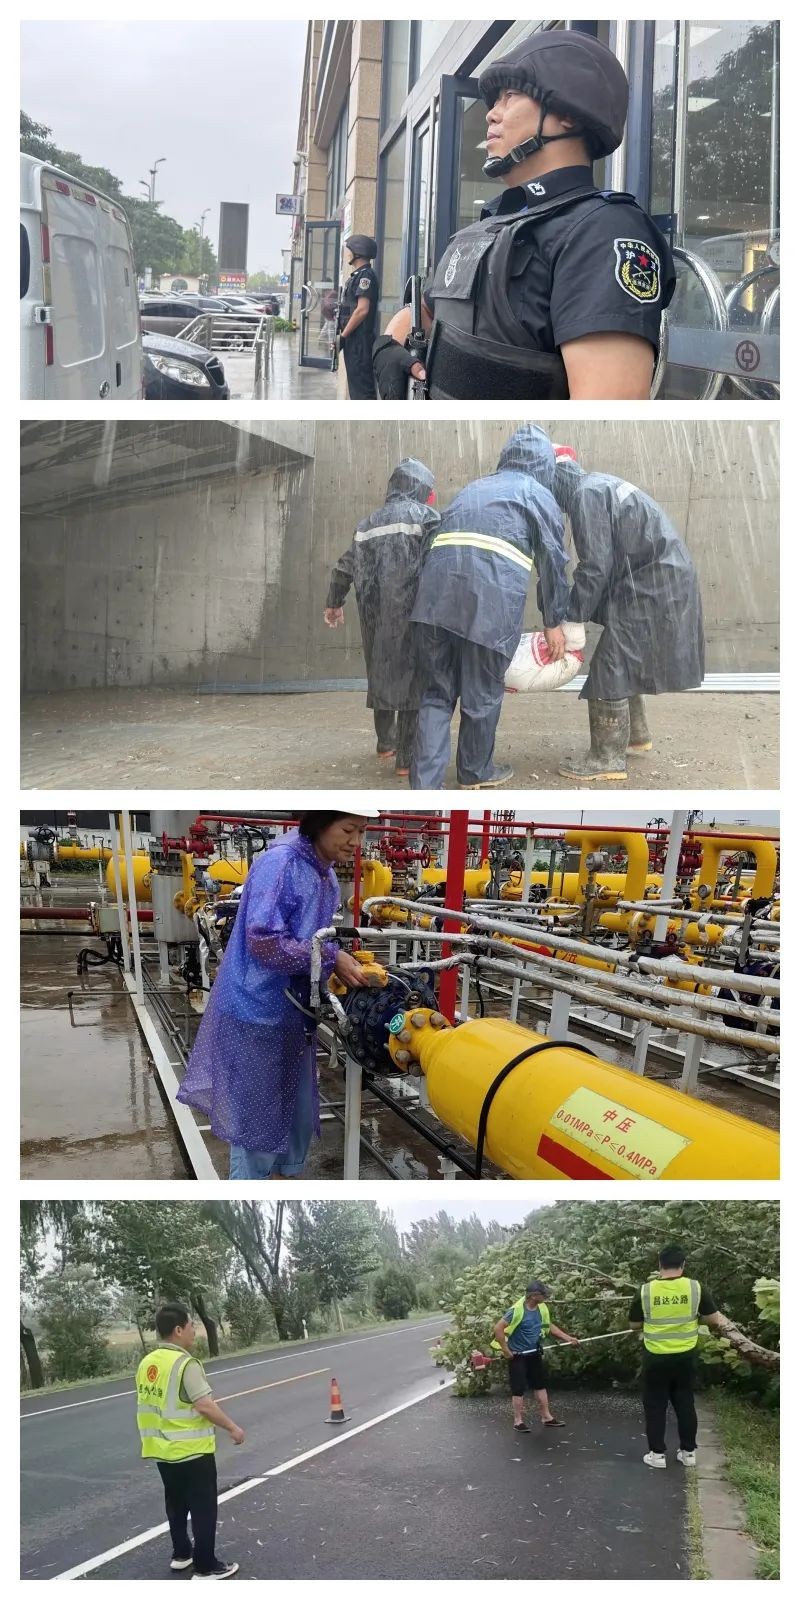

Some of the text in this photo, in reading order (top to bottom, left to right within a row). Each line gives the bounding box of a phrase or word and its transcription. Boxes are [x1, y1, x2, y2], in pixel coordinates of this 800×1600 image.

[625, 250, 636, 260] 护
[602, 1109, 636, 1133] 中压
[653, 1294, 689, 1306] 昌达公路
